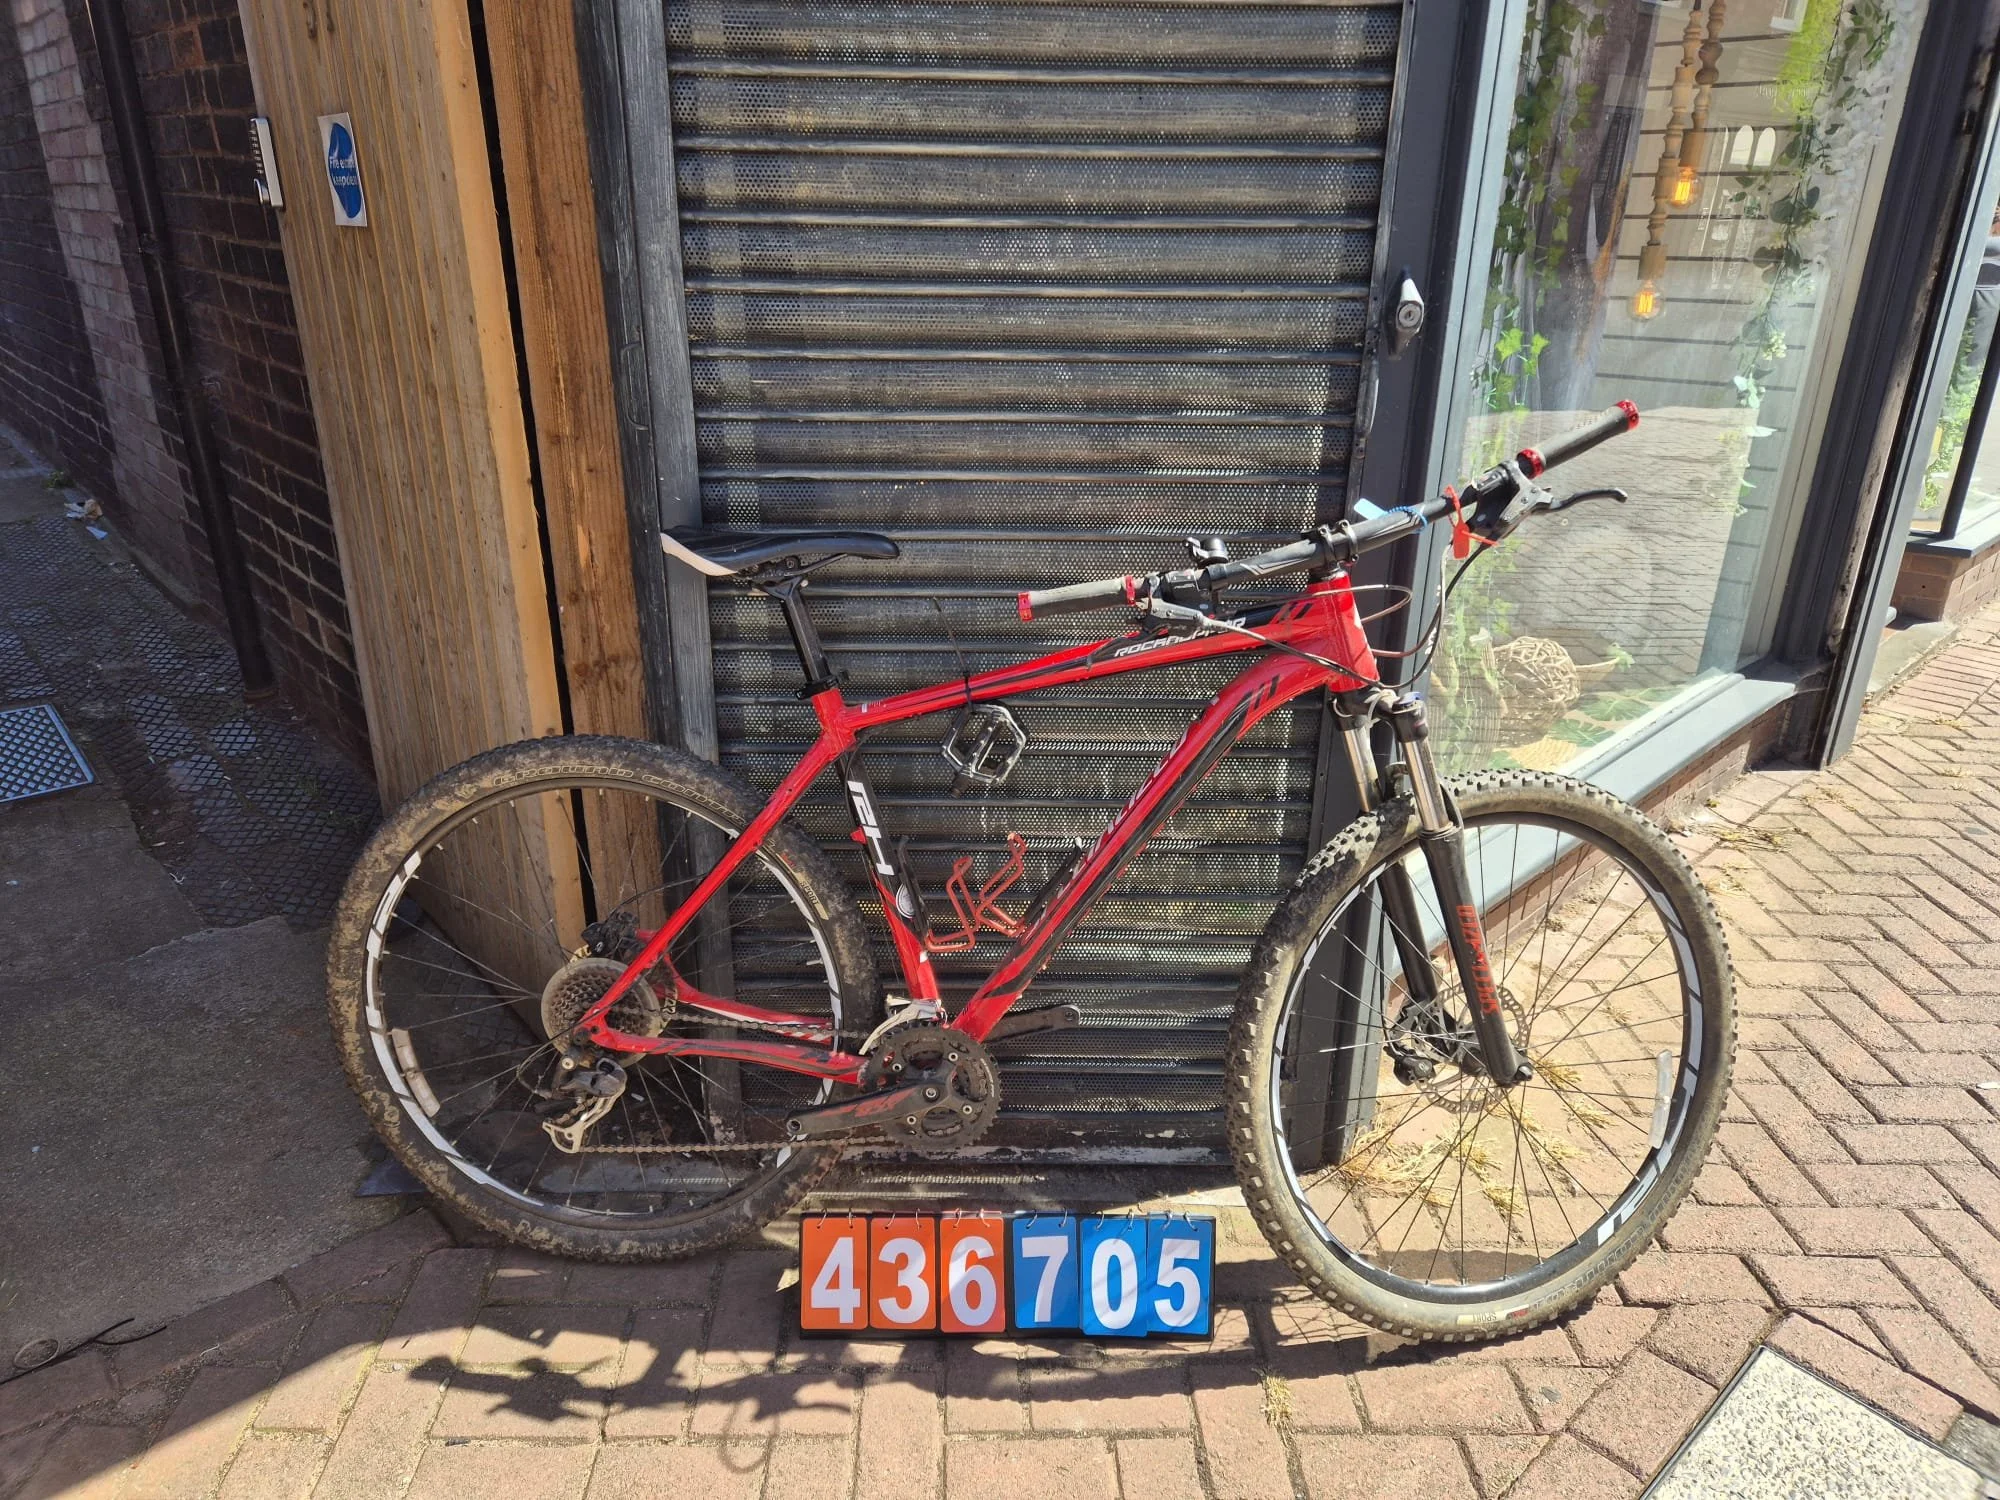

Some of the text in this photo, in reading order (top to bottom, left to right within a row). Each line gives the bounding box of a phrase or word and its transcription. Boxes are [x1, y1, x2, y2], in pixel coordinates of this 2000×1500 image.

[329, 156, 340, 169] Fire
[332, 173, 347, 188] keep
[1456, 904, 1499, 1015] SPECIIZED
